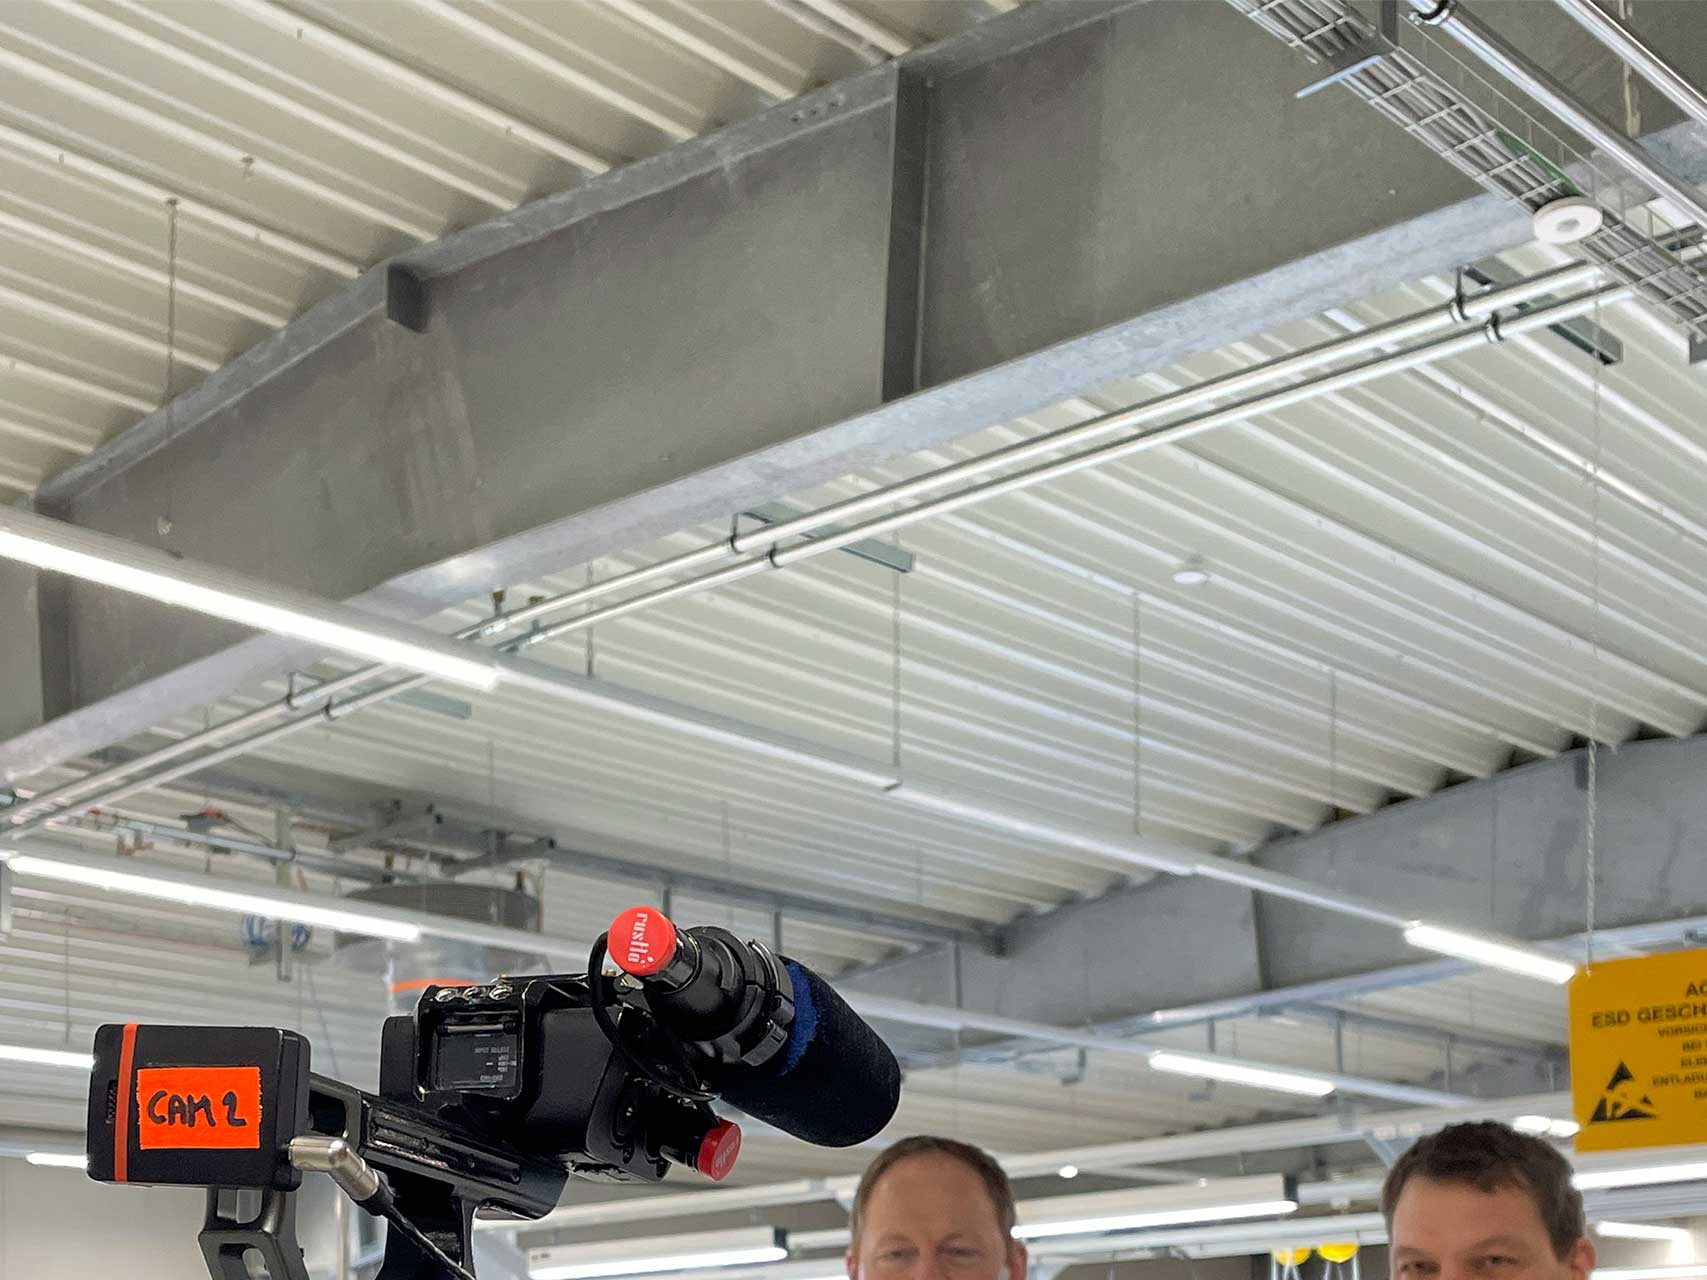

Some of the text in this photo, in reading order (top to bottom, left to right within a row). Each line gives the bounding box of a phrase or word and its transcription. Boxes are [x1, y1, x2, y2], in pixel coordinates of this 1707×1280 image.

[1591, 1009, 1631, 1028] ESD
[147, 1090, 217, 1128] CAM
[222, 1091, 247, 1127] 2
